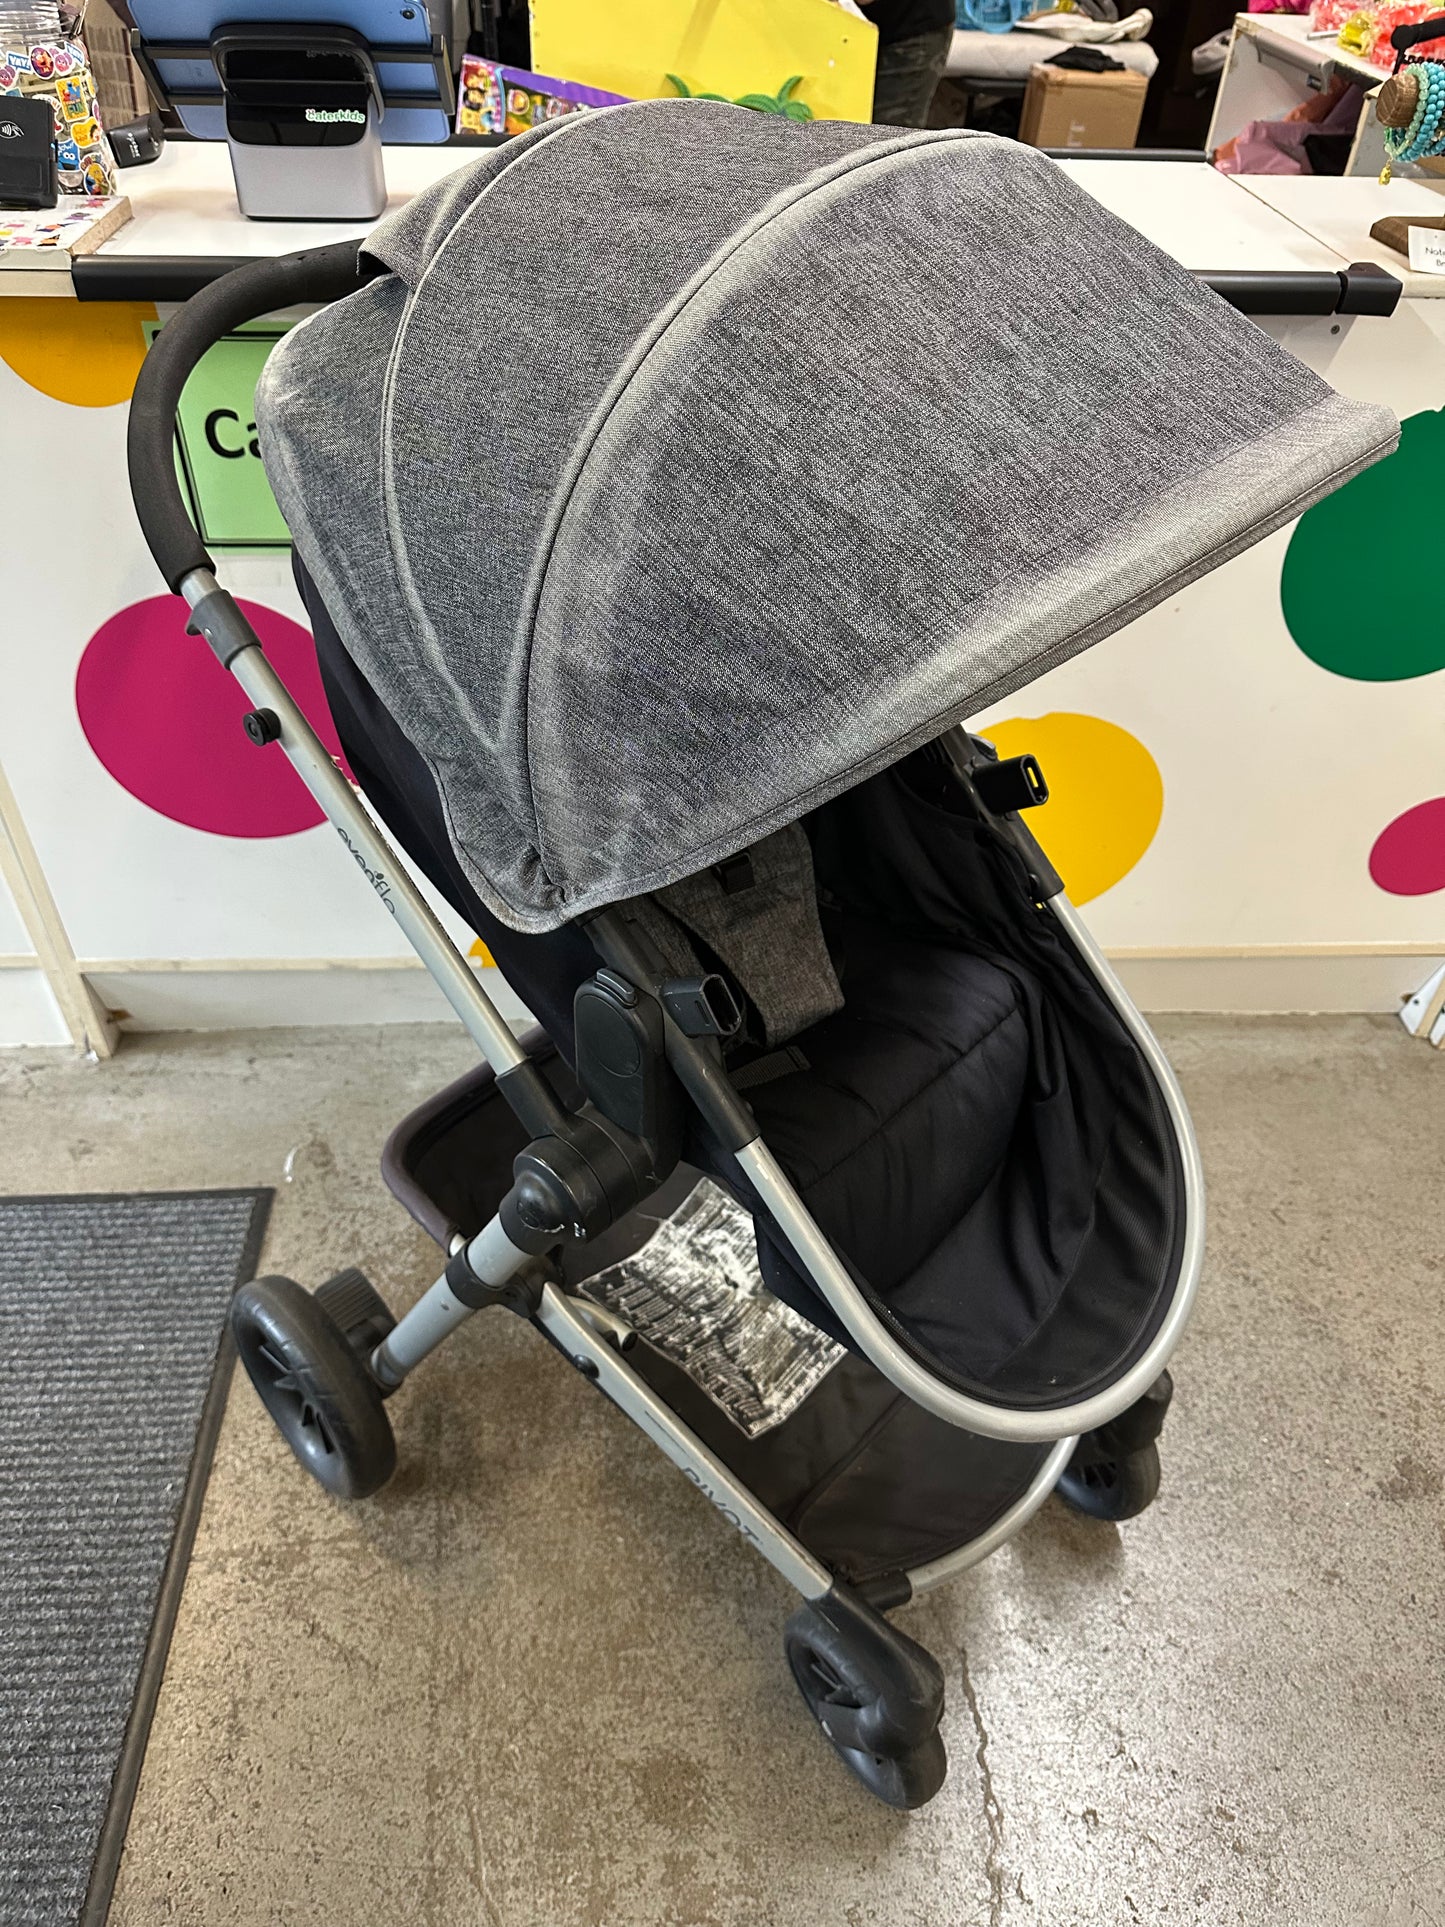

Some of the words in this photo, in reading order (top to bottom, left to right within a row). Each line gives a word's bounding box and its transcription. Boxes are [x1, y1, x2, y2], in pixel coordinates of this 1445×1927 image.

[305, 109, 365, 123] Caterkids
[337, 827, 395, 914] evenflo
[684, 1467, 760, 1541] PIVOT
